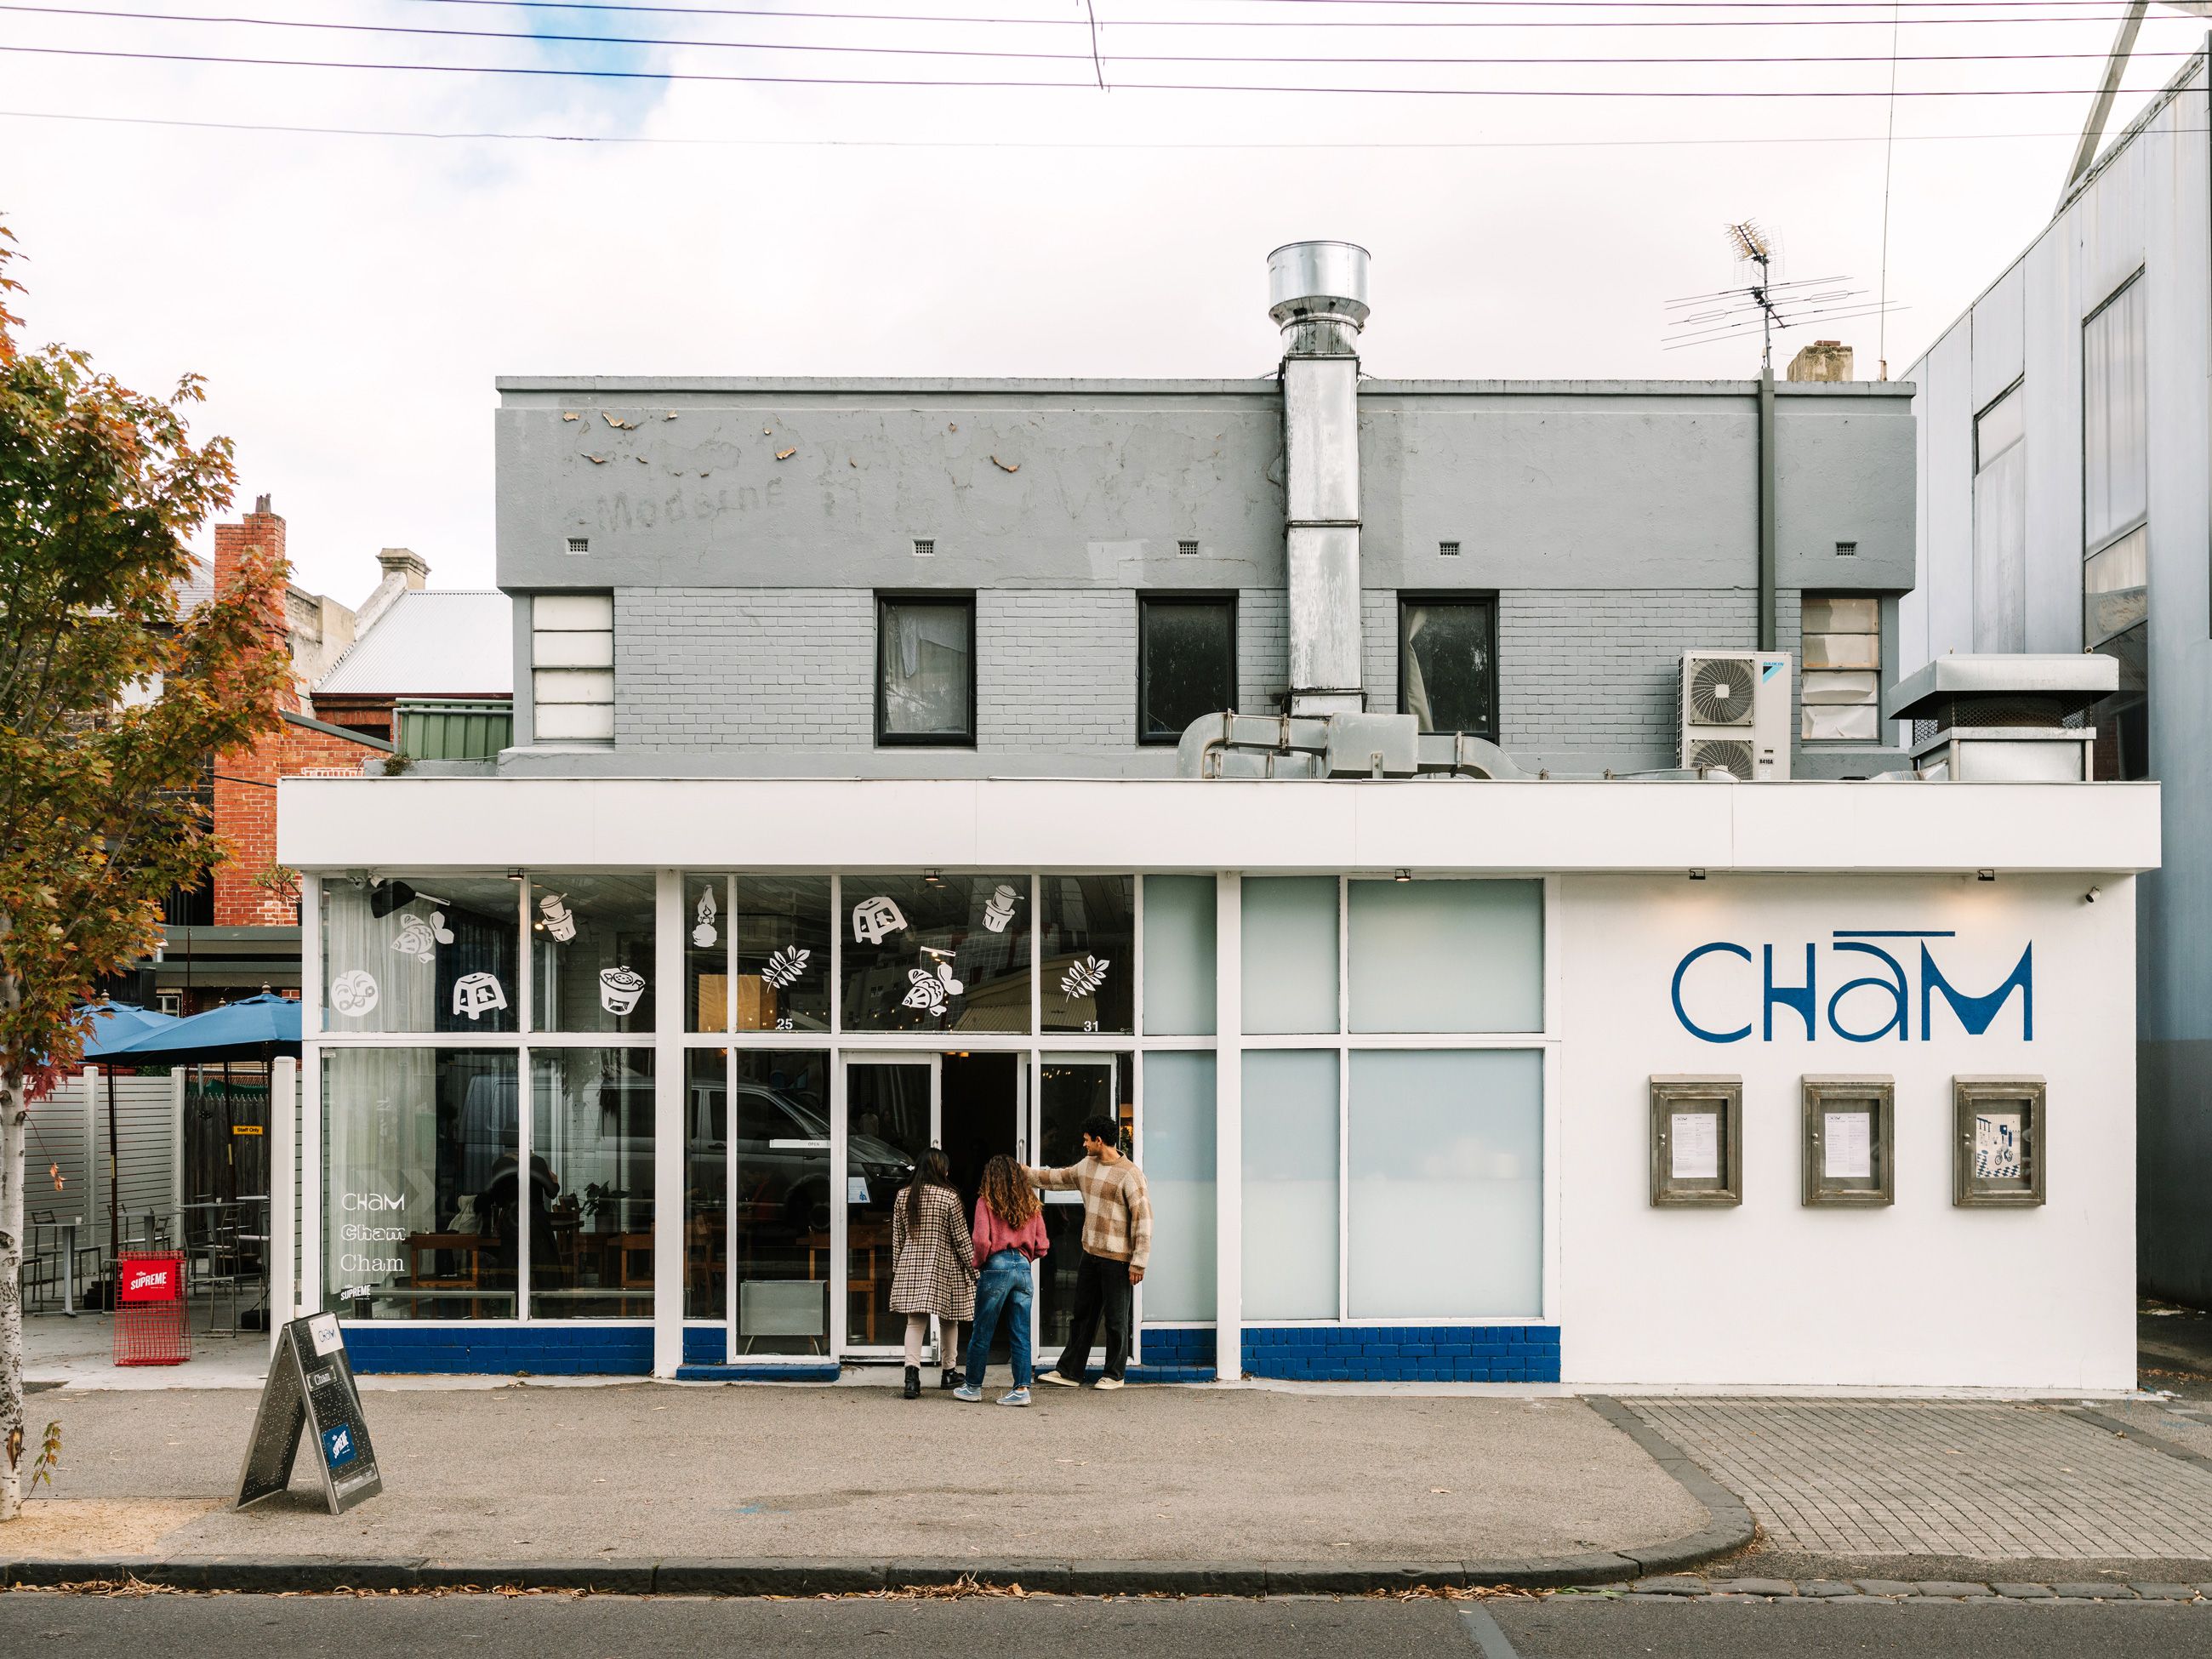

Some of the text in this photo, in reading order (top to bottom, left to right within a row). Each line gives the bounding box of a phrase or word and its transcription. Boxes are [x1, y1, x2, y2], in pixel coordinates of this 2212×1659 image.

[777, 1018, 793, 1029] 25
[1083, 1021, 1098, 1032] 31
[340, 1224, 406, 1241] Cham
[340, 1253, 405, 1272] Cham
[130, 1272, 168, 1291] SUPREME
[340, 1285, 371, 1301] SUPREME
